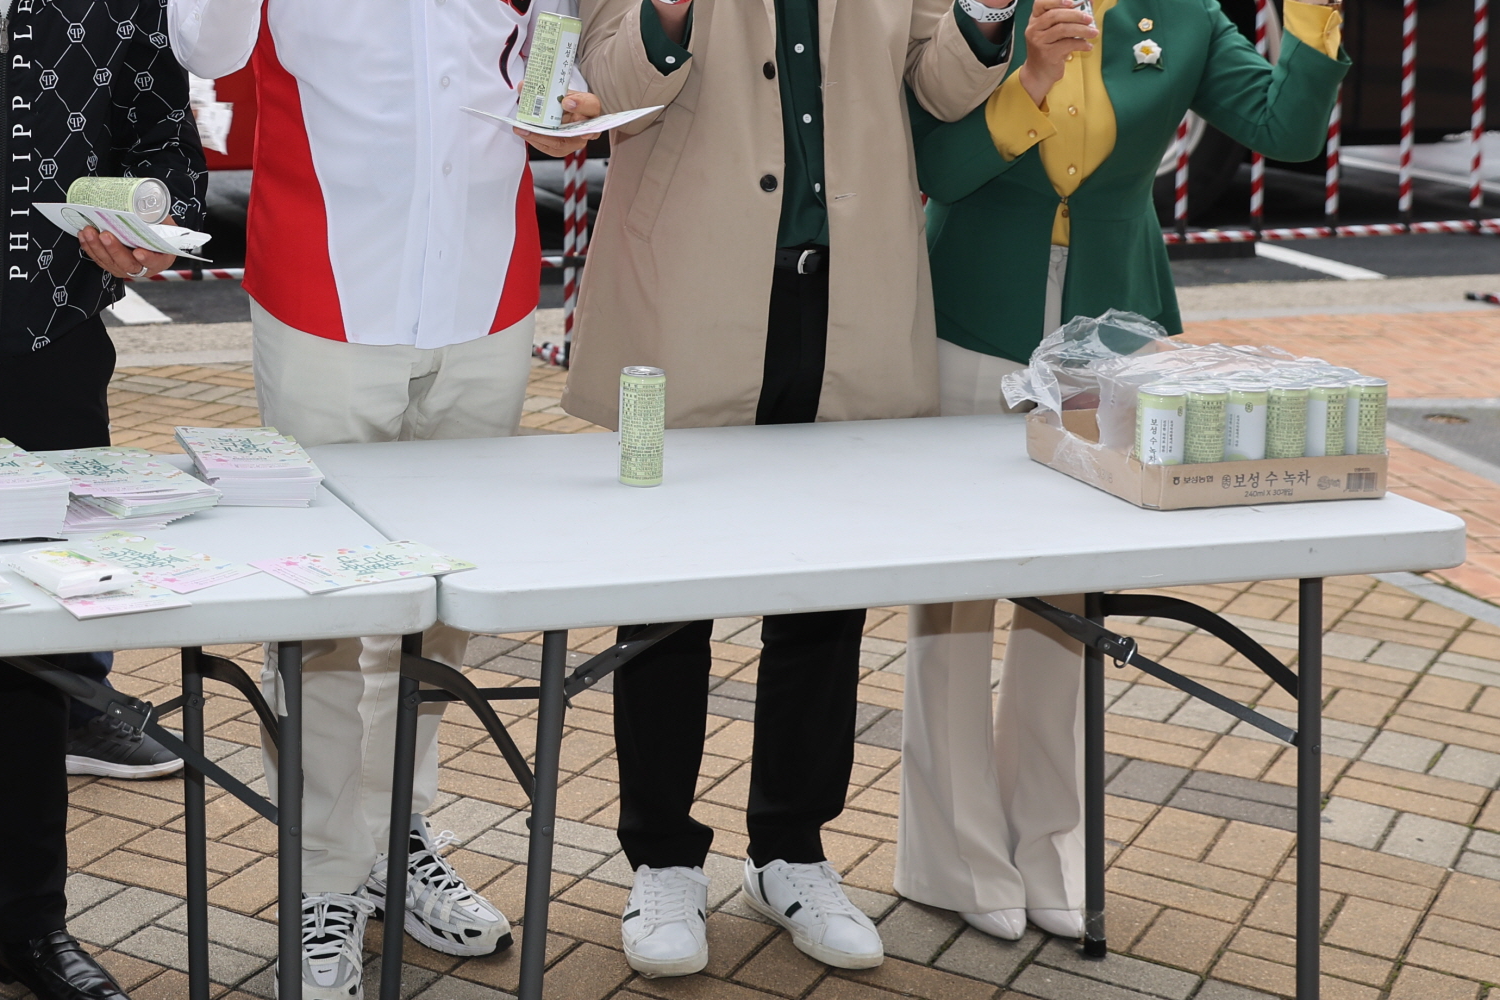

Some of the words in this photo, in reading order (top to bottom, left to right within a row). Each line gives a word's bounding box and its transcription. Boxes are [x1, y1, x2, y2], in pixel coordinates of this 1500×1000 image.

[1233, 471, 1260, 488] 보성
[1265, 471, 1279, 486] 수
[1282, 469, 1311, 487] 녹차
